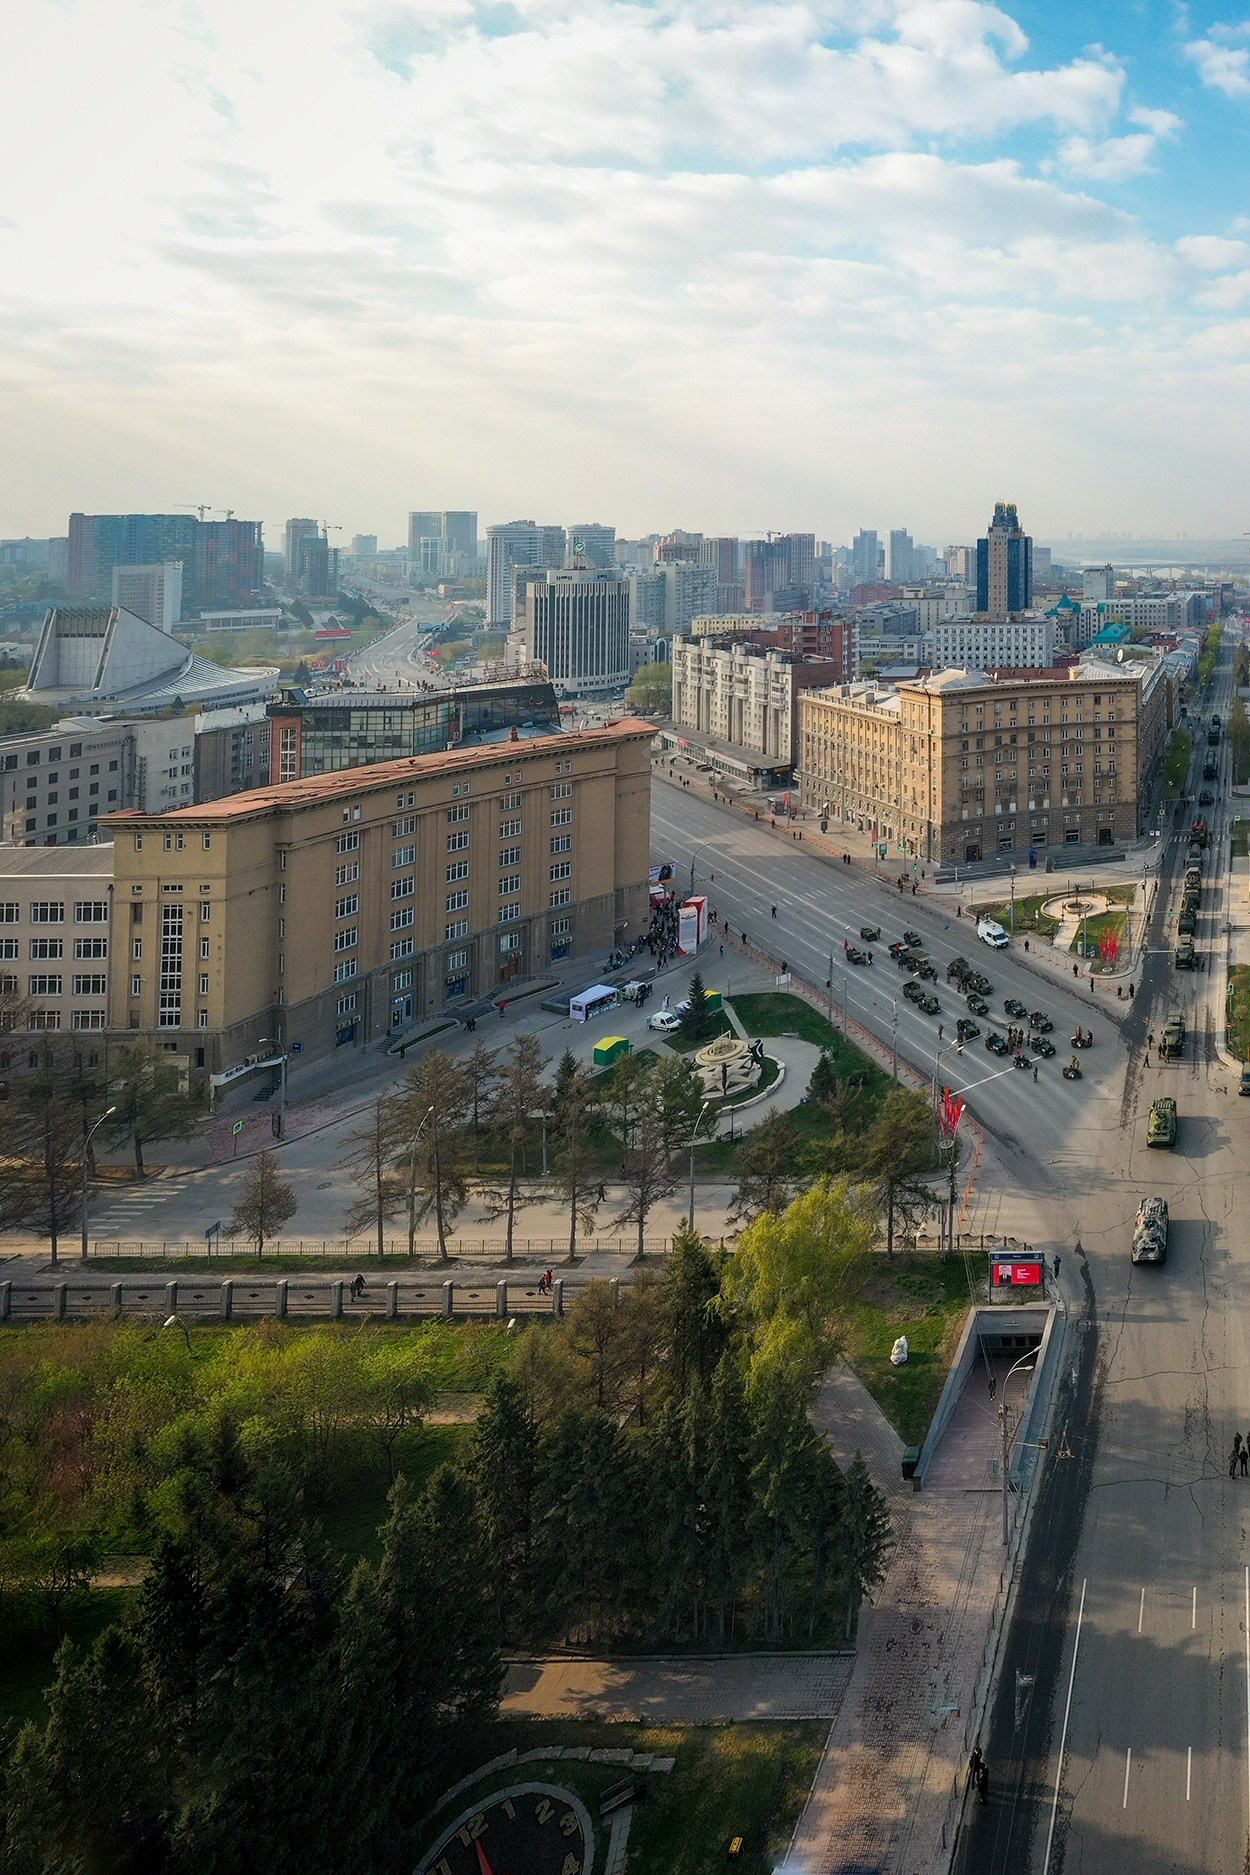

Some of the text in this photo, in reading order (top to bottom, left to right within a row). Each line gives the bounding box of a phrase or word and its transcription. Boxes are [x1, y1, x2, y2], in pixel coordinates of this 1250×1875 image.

[501, 1799, 517, 1820] 1
[535, 1799, 555, 1825] 2
[456, 1813, 489, 1848] 12
[559, 1810, 580, 1837] 3
